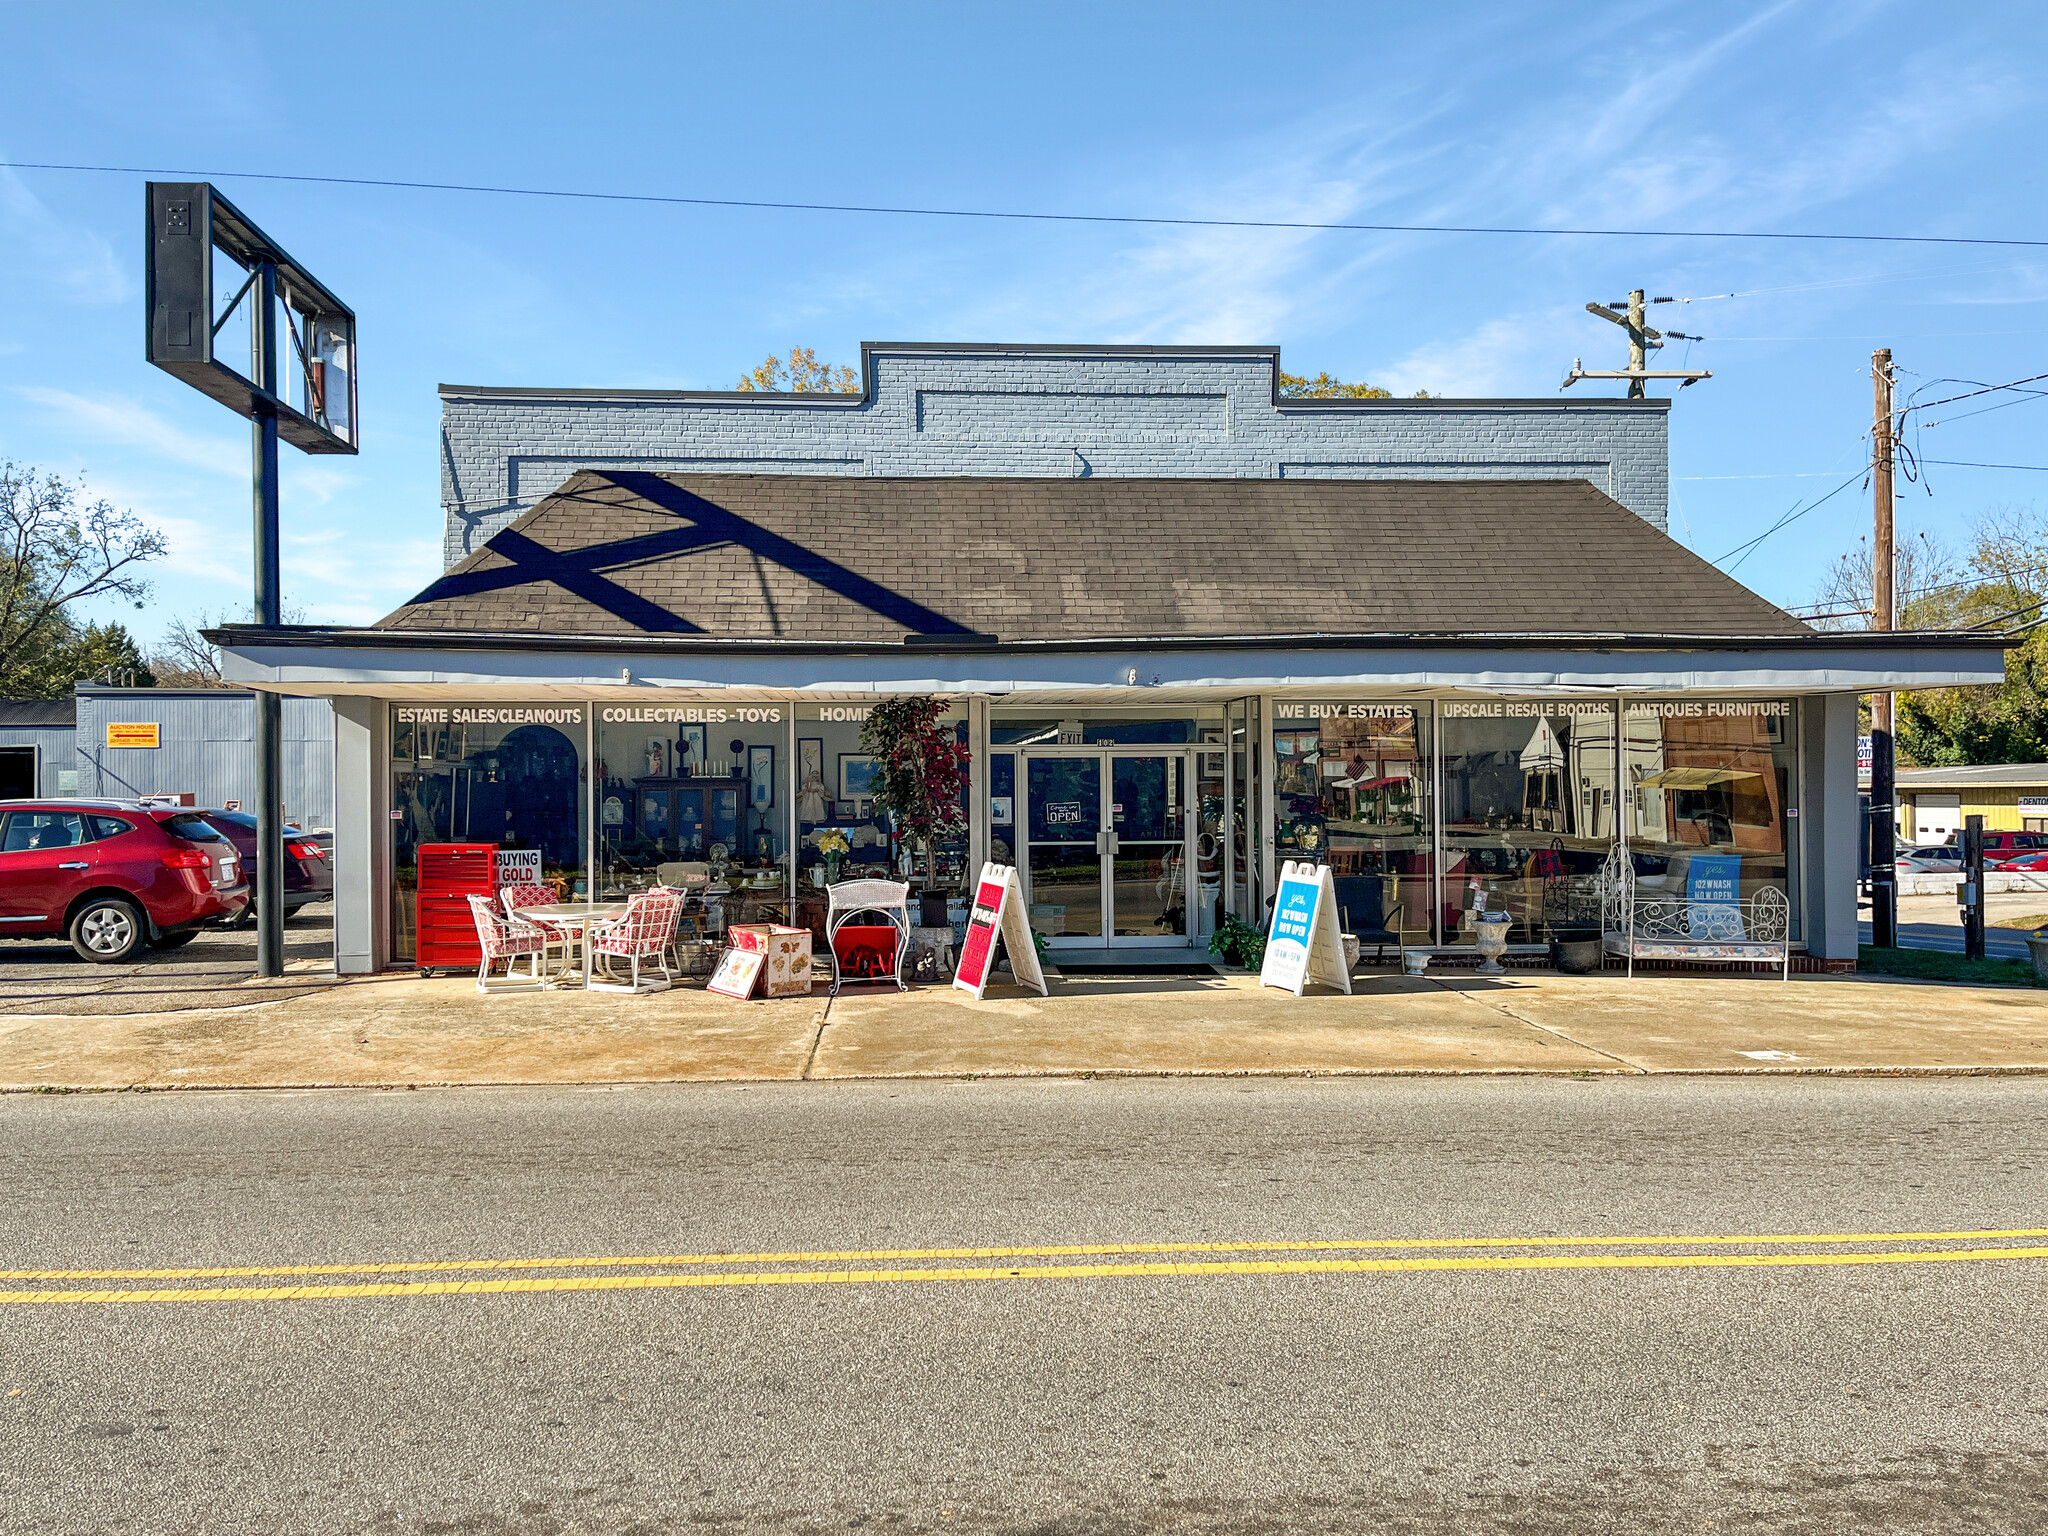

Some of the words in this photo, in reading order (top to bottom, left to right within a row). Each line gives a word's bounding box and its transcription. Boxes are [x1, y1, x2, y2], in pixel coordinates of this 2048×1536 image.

[397, 708, 448, 723] ESTATE
[452, 708, 582, 724] SALES/CLEANOUTS
[602, 707, 727, 723] COLLECTABLES
[1278, 704, 1304, 718] WE
[1309, 704, 1343, 719] BUY
[1347, 704, 1413, 719] ESTATES
[1443, 703, 1502, 718] UPSCALE
[1506, 703, 1554, 717] RESALE
[1557, 702, 1610, 717] BOOTHS
[1628, 702, 1703, 718] ANTIQUES
[1707, 702, 1790, 717] FURNITURE
[1060, 733, 1082, 744] EXIT
[1049, 810, 1079, 822] OPEN
[502, 868, 533, 882] GOLD
[1695, 880, 1706, 889] 102
[1713, 880, 1732, 889] NASH
[1695, 891, 1712, 899] NOW
[1713, 891, 1732, 899] OPEN
[1278, 922, 1292, 934] NOW
[1290, 924, 1307, 937] OPEN
